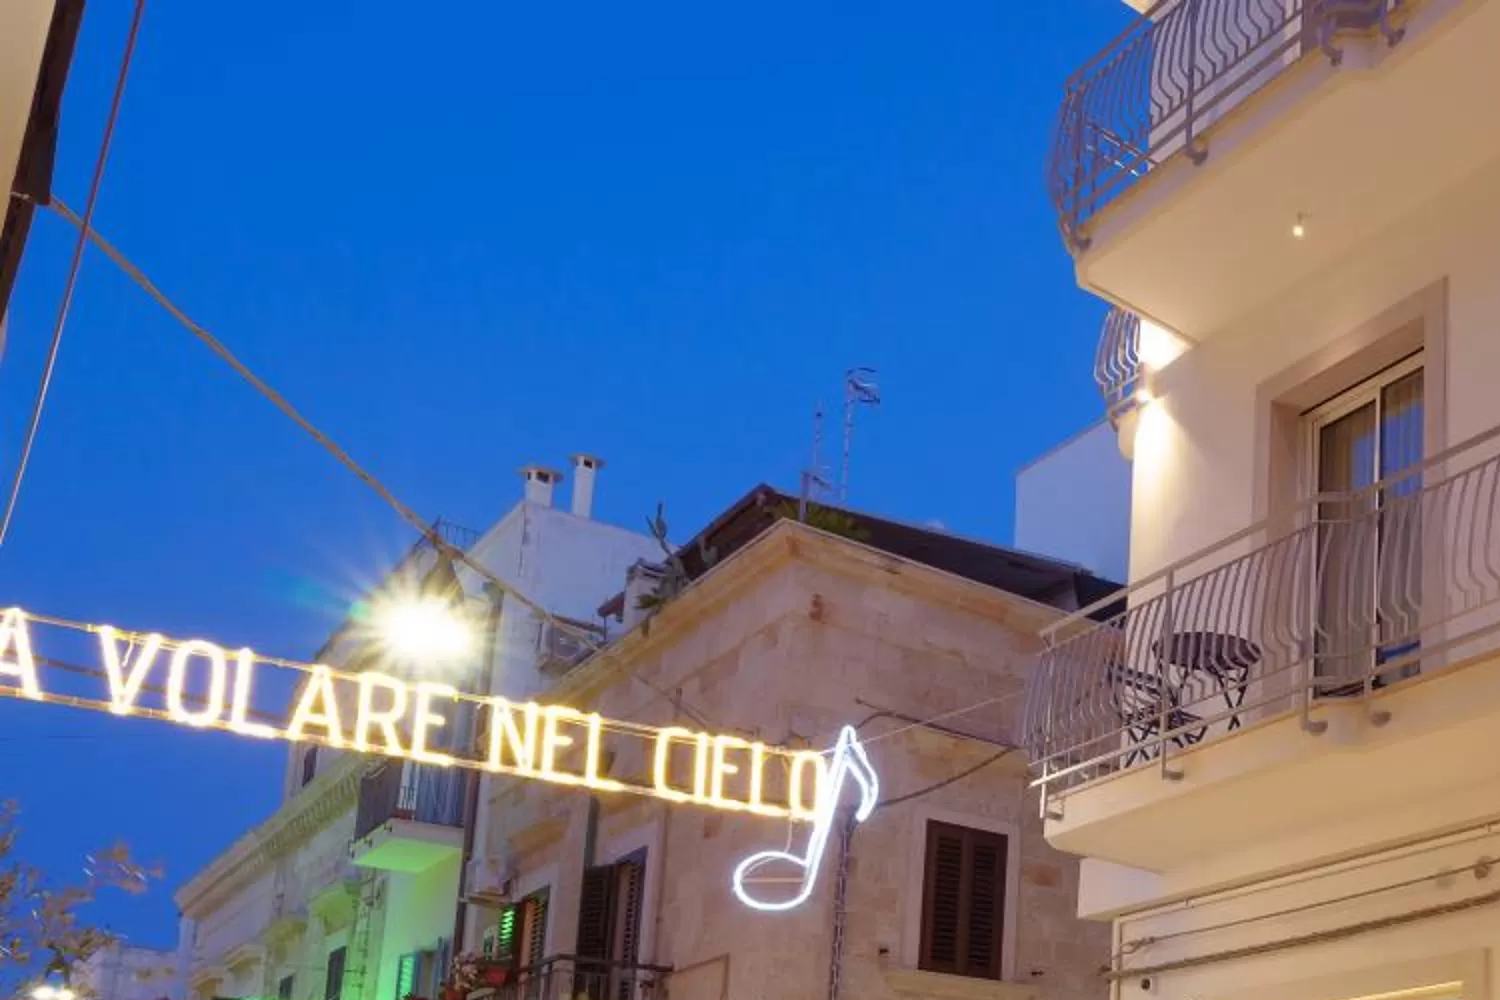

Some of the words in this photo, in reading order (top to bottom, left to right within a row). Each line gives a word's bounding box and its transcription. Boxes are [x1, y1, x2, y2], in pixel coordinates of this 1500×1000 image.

[0, 606, 43, 700] A
[99, 624, 455, 767] VOLARE
[487, 694, 624, 792] NEL
[653, 725, 828, 822] CIELO
